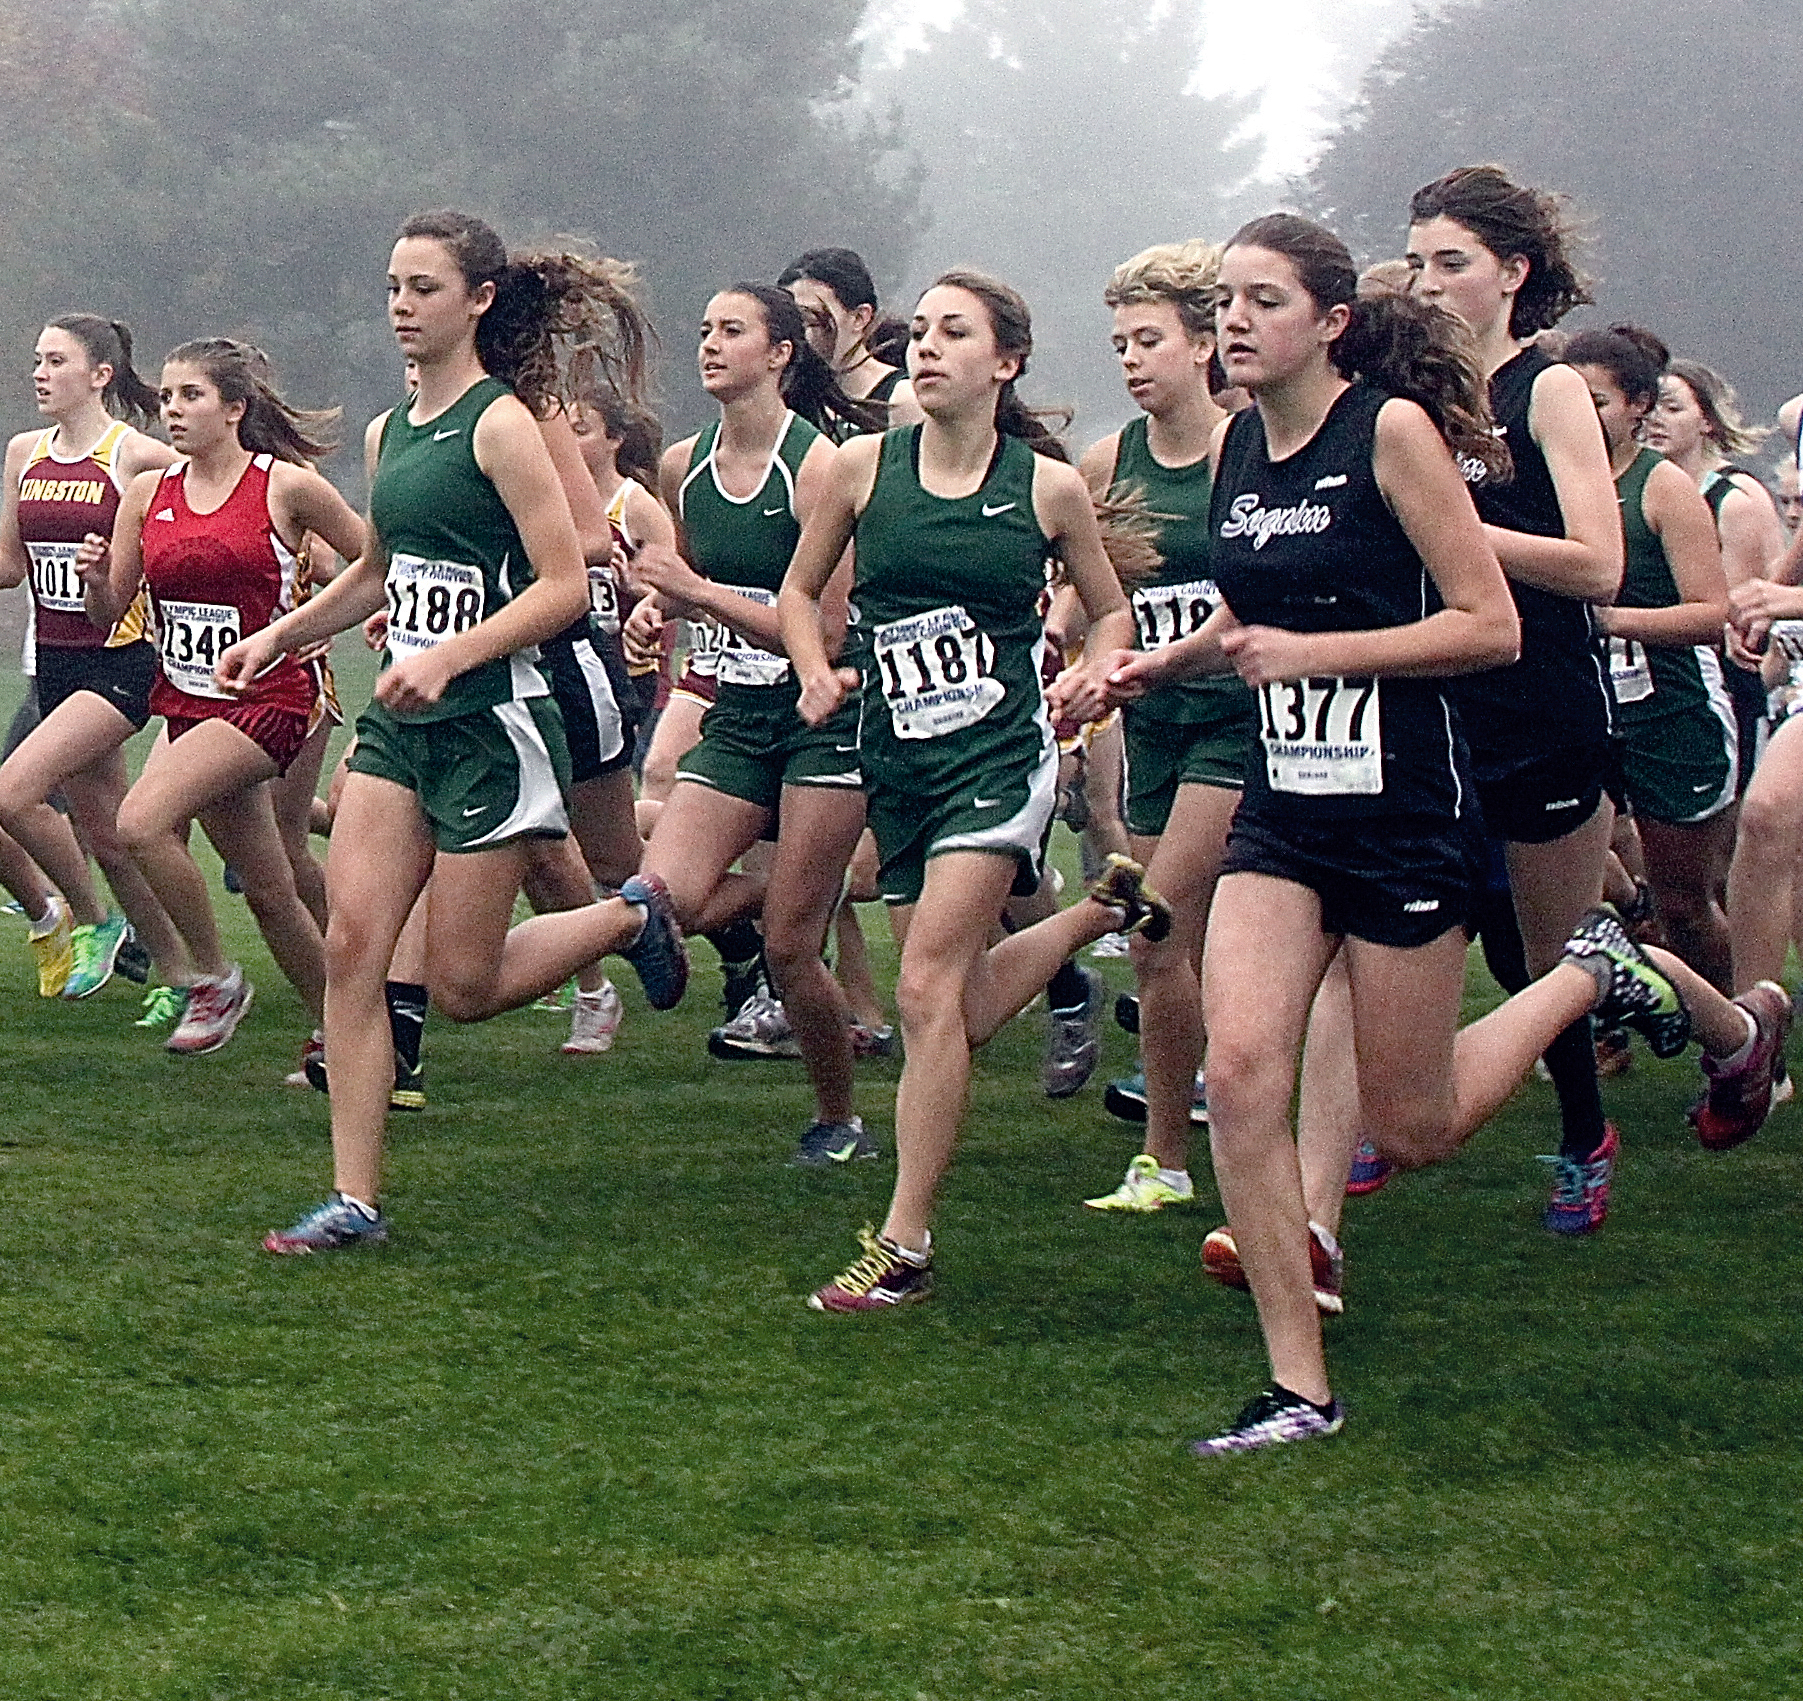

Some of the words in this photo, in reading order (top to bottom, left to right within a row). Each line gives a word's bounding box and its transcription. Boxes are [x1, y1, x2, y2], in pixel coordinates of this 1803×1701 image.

[387, 579, 480, 634] 1188
[164, 618, 237, 666] 1348
[1263, 675, 1375, 742] 1377
